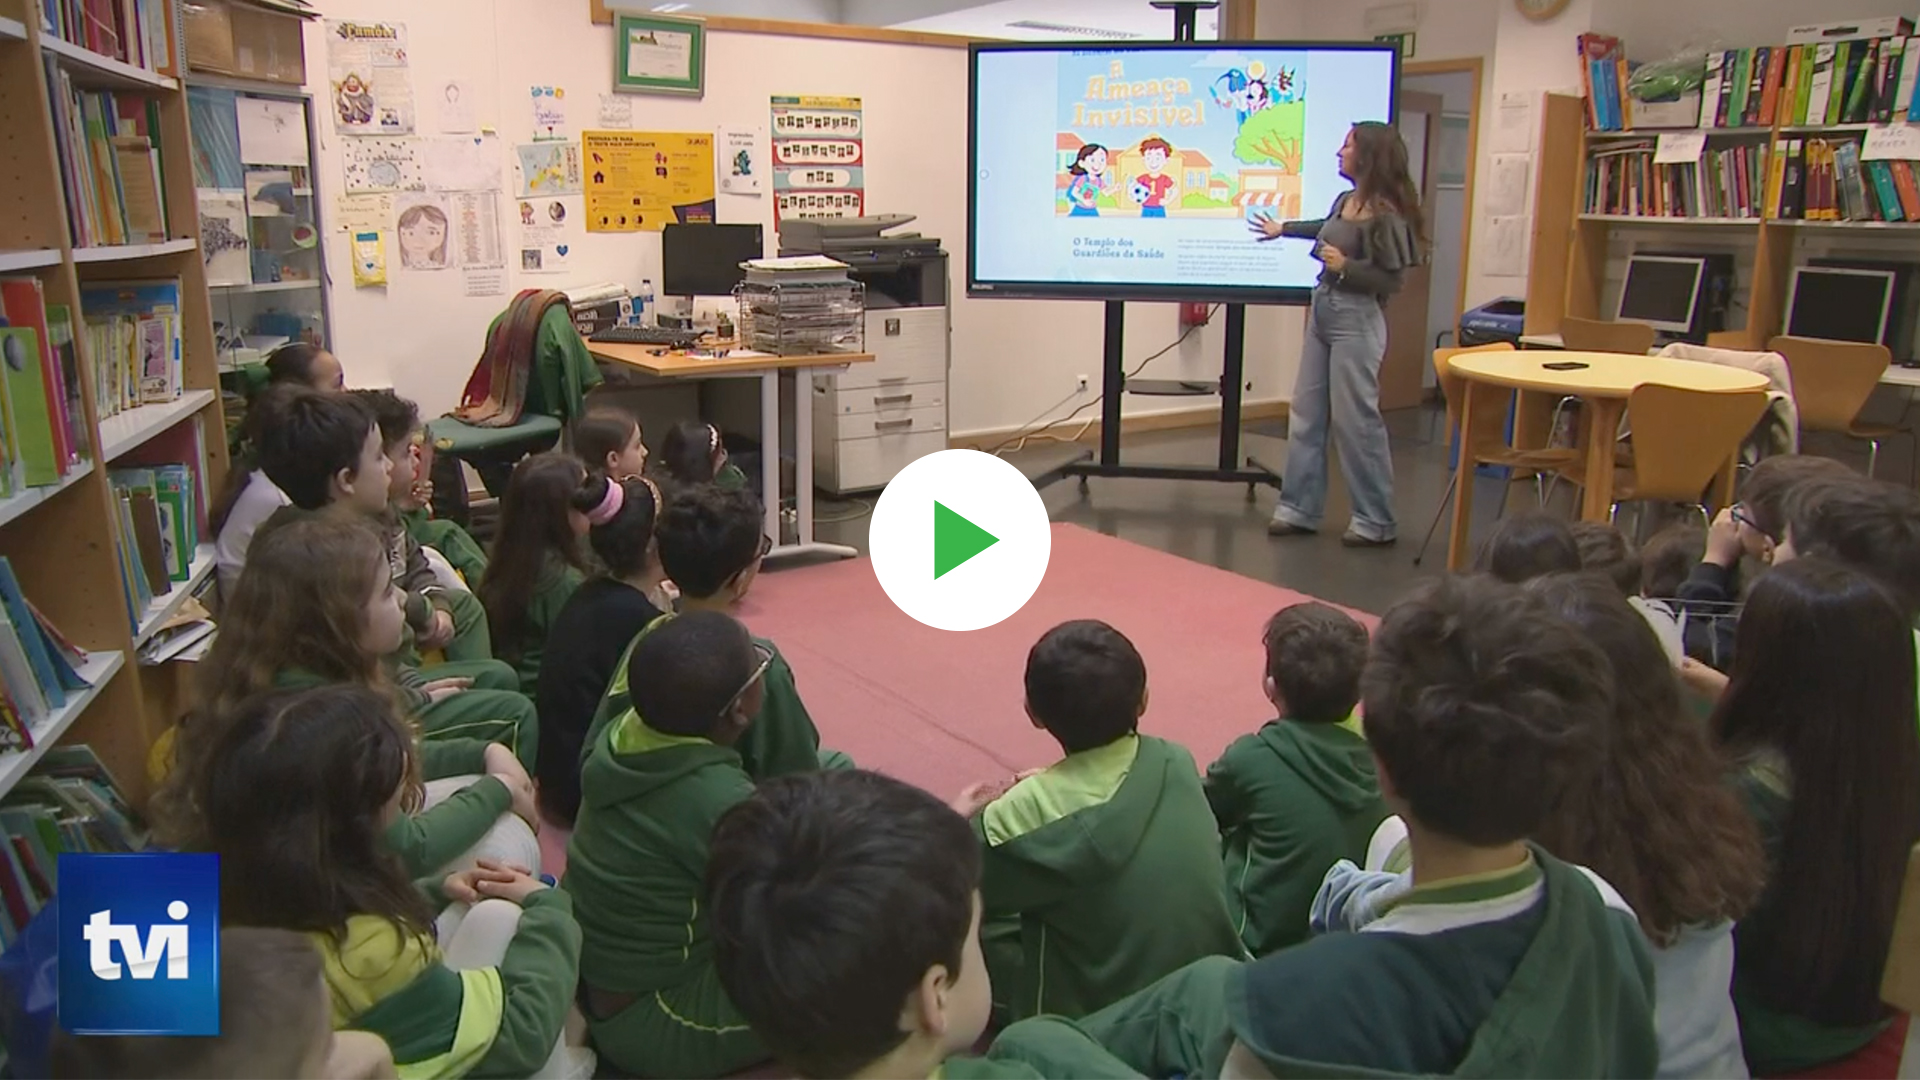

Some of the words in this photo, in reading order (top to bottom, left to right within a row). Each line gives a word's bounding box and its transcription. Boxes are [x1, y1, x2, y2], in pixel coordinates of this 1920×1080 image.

[1109, 60, 1123, 79] A
[1085, 75, 1192, 104] Ameaça
[1072, 99, 1205, 128] Invisível
[1073, 237, 1081, 246] O
[1084, 237, 1115, 248] Templo
[1117, 238, 1134, 247] dos
[1073, 246, 1120, 258] Guardiões
[1122, 248, 1134, 258] da
[1137, 246, 1165, 259] Saúde
